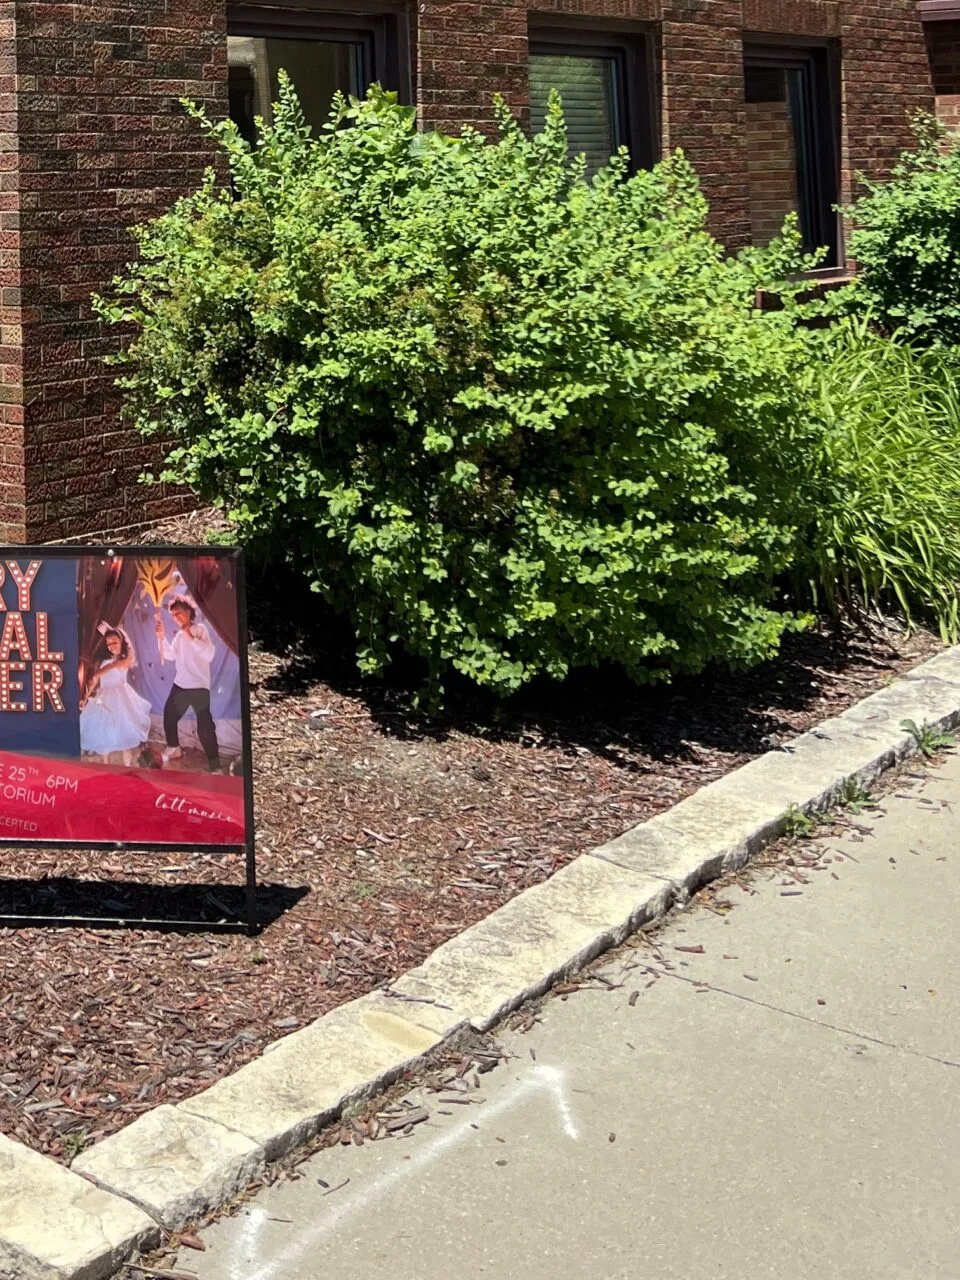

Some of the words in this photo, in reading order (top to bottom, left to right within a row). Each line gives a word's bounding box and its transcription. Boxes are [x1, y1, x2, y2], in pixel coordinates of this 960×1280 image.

[45, 774, 79, 793] 6PM
[155, 793, 193, 813] lott
[188, 807, 236, 823] music
